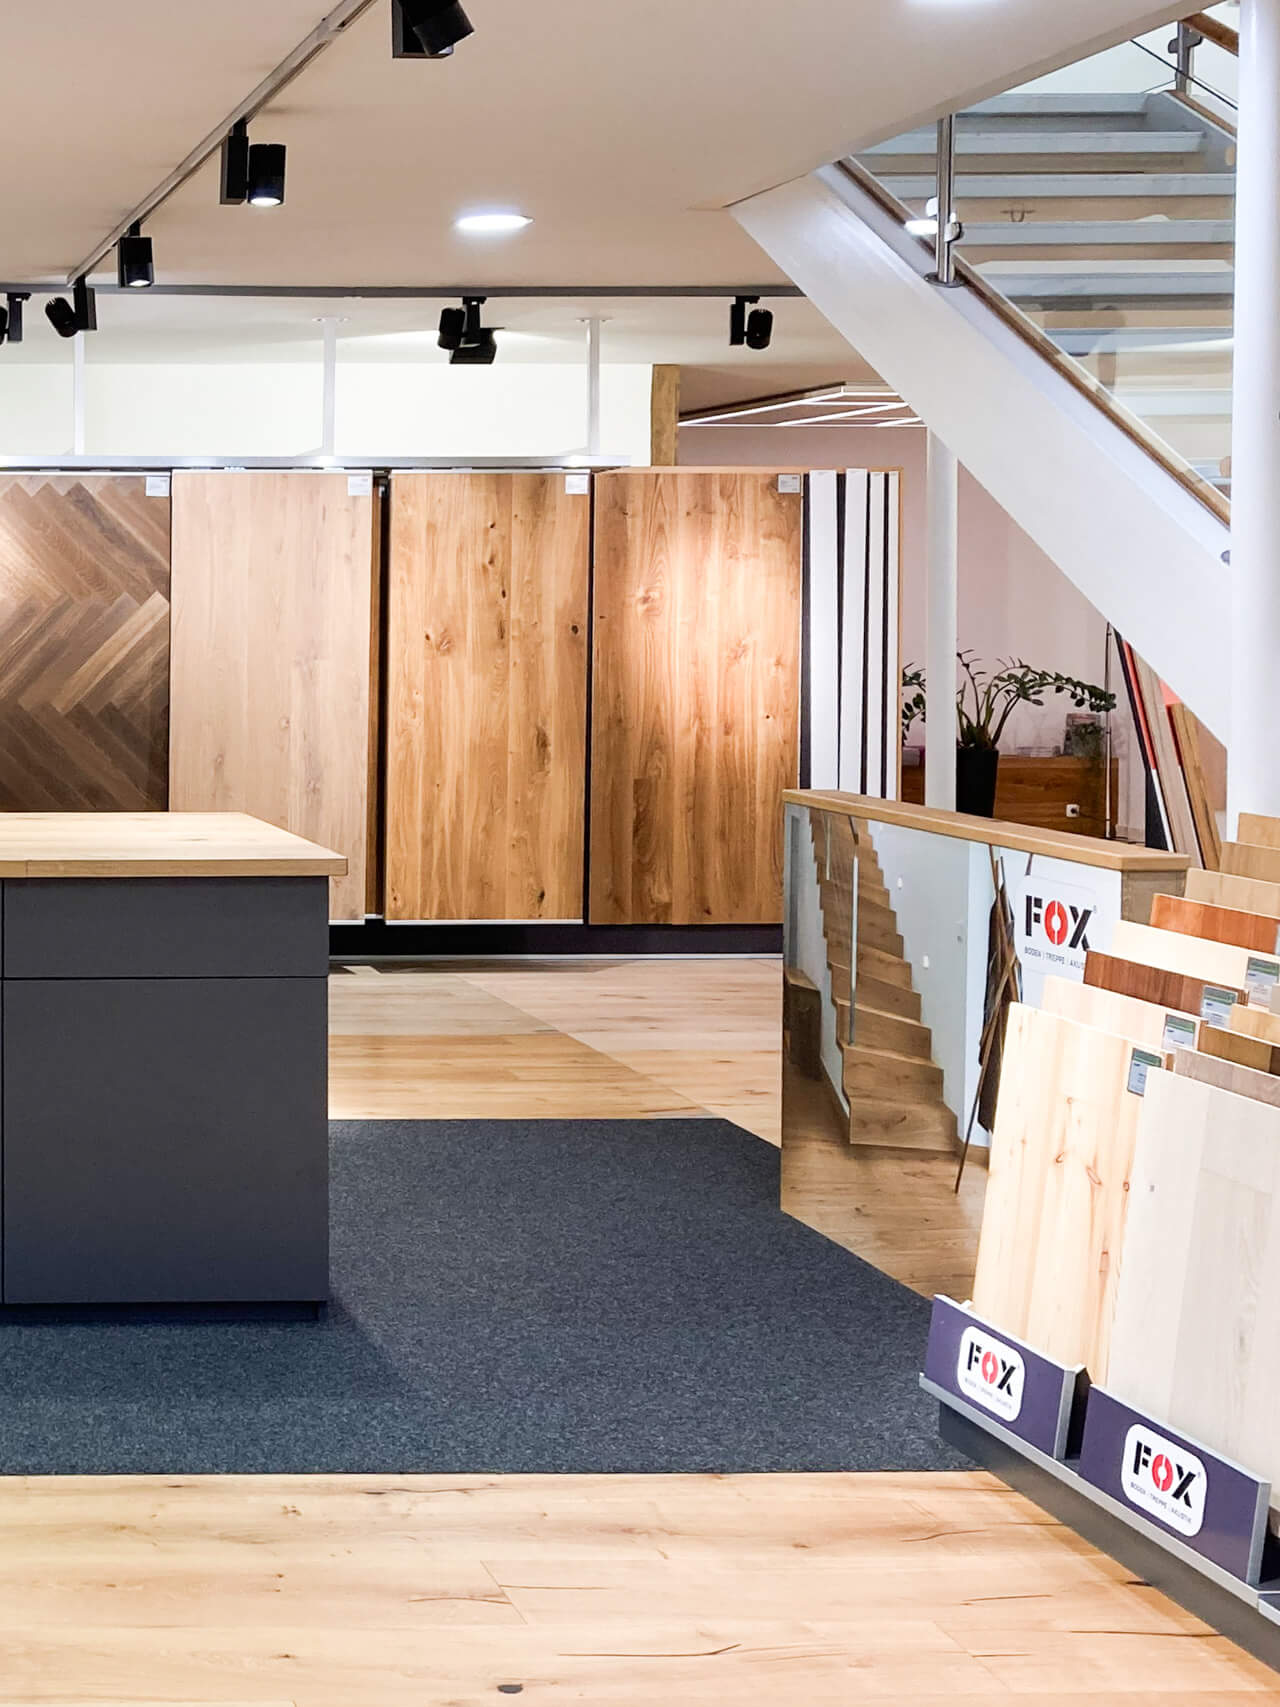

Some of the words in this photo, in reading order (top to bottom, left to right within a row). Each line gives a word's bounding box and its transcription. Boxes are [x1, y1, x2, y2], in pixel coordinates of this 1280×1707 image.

[1025, 895, 1093, 951] FOX
[967, 1341, 1017, 1397] FOX
[1133, 1440, 1197, 1509] FOX
